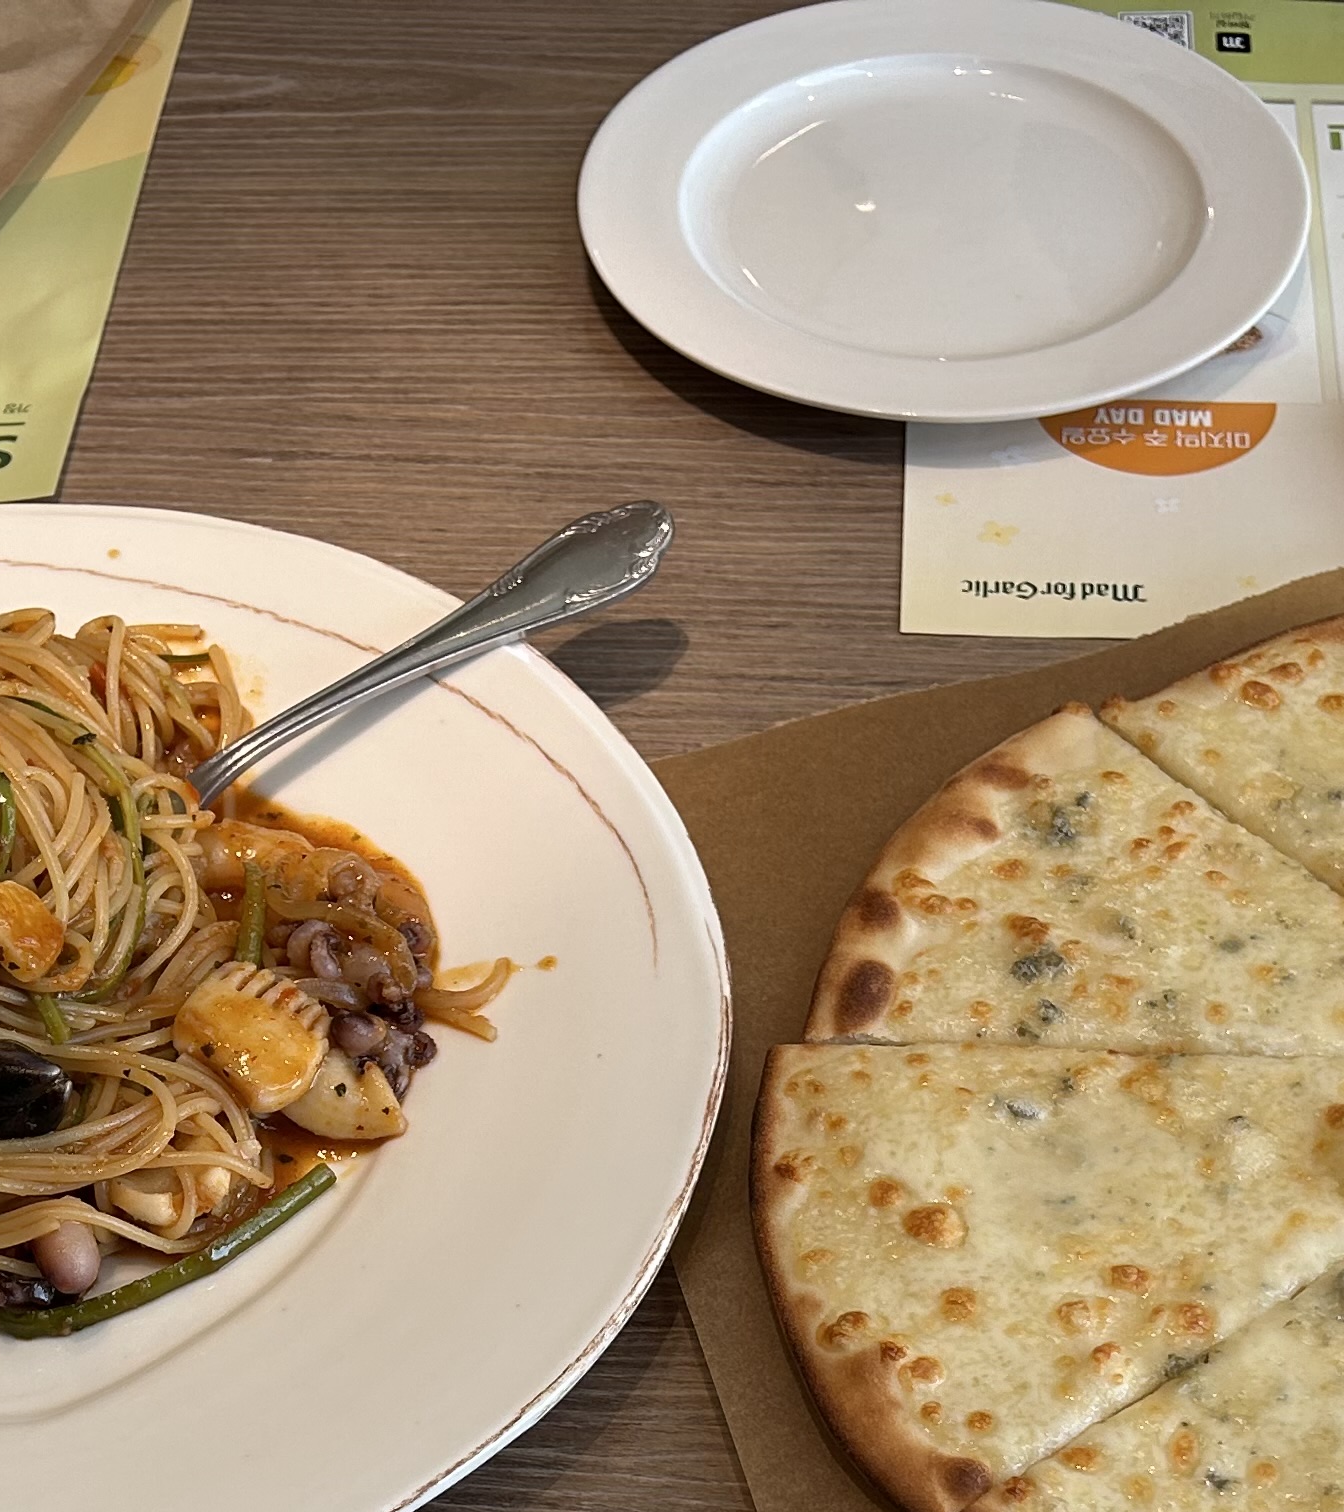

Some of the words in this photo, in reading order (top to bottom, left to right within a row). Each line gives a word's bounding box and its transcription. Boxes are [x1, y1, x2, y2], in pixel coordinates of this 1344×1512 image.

[1094, 407, 1144, 425] DAY
[1153, 410, 1214, 427] MAD
[1061, 427, 1137, 446] 수요일
[1143, 430, 1168, 447] 주
[1175, 431, 1251, 448] 마지막
[961, 579, 1038, 600] Garlic
[1040, 581, 1076, 600] for
[1081, 582, 1147, 602] Mad
